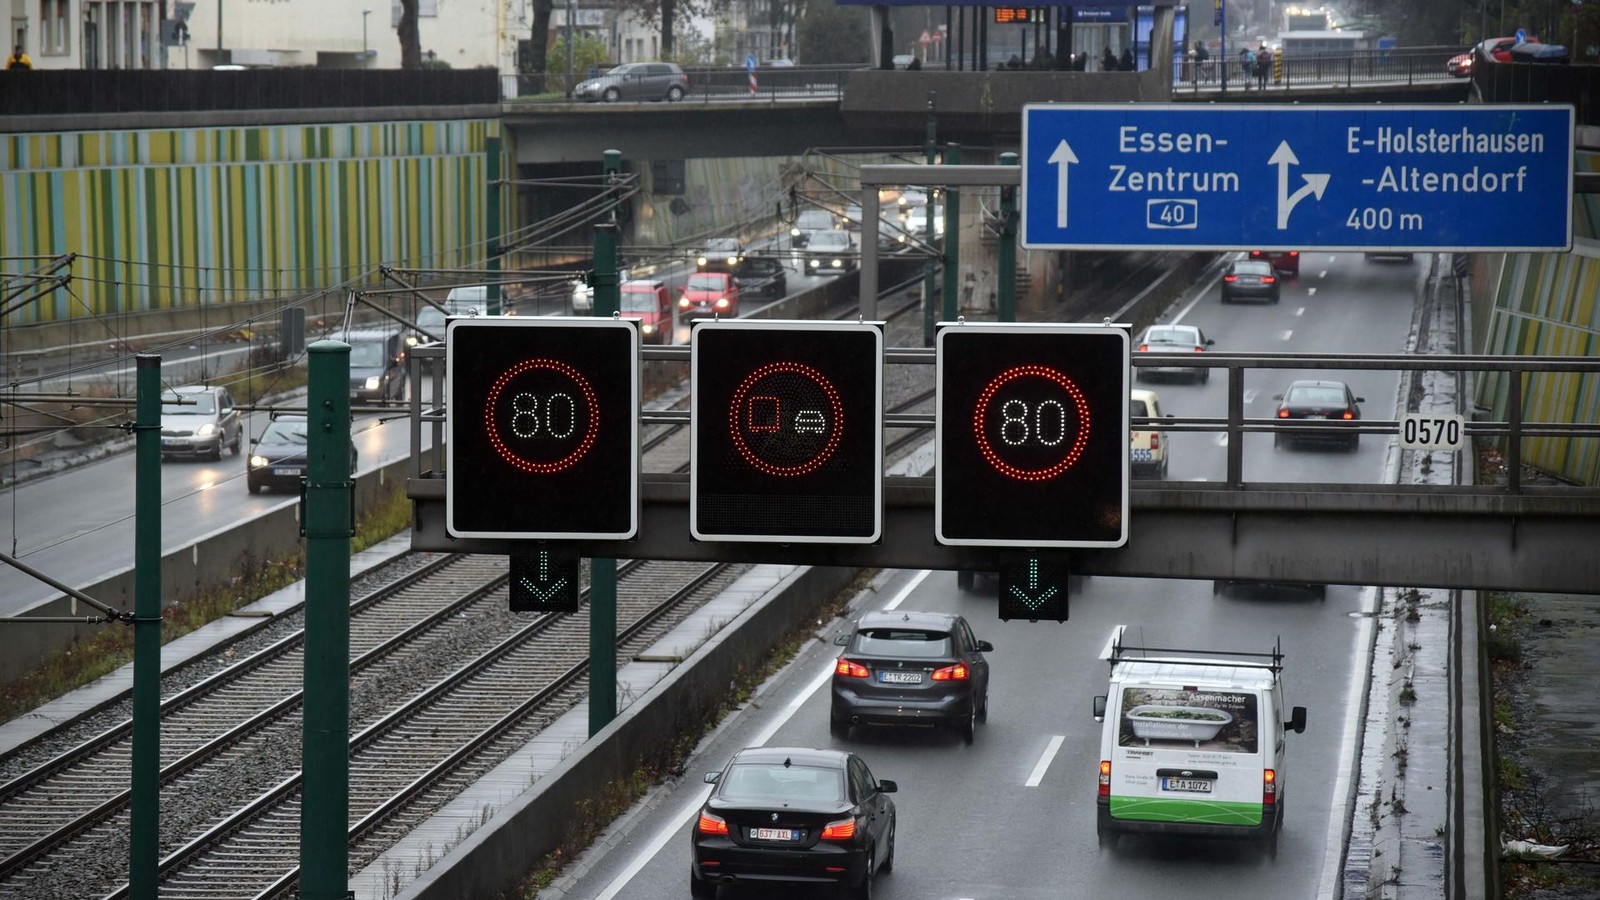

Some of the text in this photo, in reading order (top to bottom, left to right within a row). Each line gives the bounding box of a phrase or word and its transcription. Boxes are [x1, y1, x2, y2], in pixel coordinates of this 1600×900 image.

[1119, 126, 1228, 153] Essen-
[1347, 126, 1544, 154] E-Holsterhausen
[1108, 165, 1239, 192] Zentrum
[1362, 166, 1527, 192] -Altendorf
[1160, 204, 1185, 223] 40
[1346, 207, 1423, 230] 400 m
[512, 392, 575, 438] 80
[1001, 399, 1065, 446] 80
[1405, 418, 1459, 445] 0570
[1189, 693, 1246, 703] Assenmacher
[759, 830, 772, 838] 637
